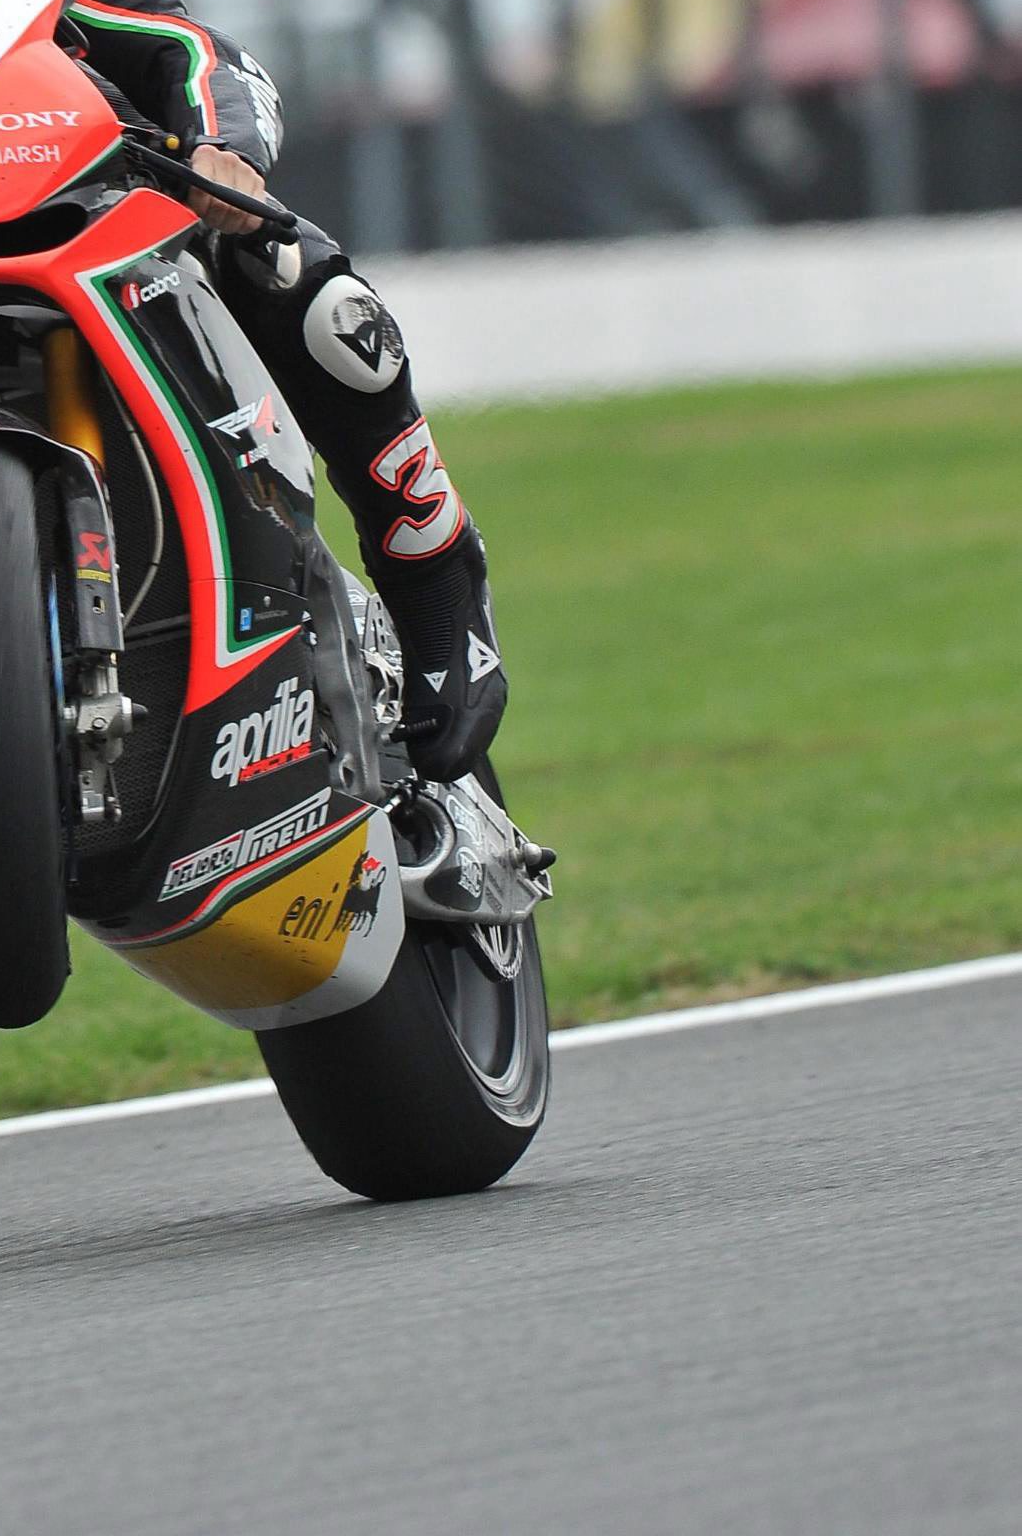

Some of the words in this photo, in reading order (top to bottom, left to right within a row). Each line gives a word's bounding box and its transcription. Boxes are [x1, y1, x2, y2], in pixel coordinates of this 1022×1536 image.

[369, 415, 464, 560] 3
[211, 677, 315, 787] aprilia
[235, 786, 332, 868] PIRELLI
[279, 881, 339, 939] eni
